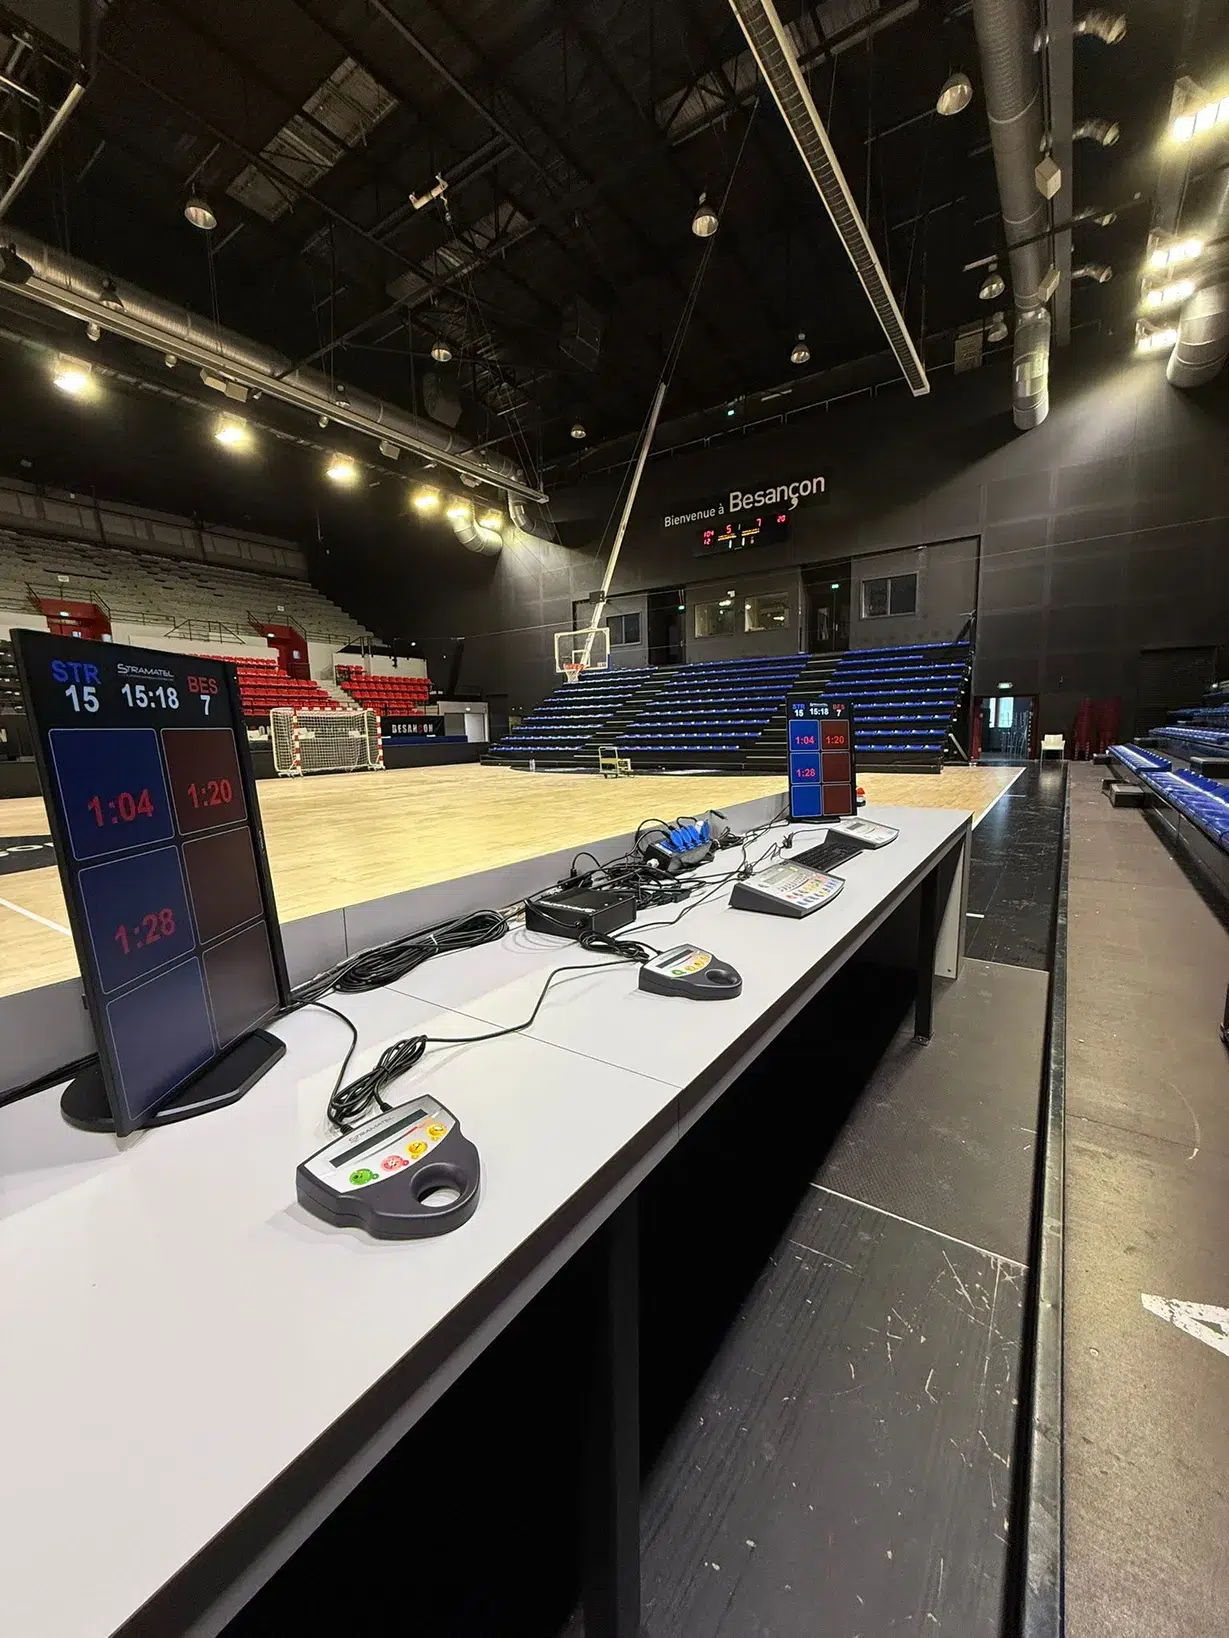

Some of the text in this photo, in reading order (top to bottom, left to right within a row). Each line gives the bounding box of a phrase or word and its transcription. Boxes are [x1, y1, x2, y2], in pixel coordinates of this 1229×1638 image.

[664, 476, 825, 527] Bienvenue à Besançon
[52, 660, 101, 685] STR
[117, 663, 175, 678] STRAMATEL
[188, 676, 219, 695] BES
[65, 685, 100, 713] 15
[121, 683, 180, 710] 15:18
[200, 695, 211, 716] 7
[794, 709, 804, 717] 15
[809, 707, 829, 716] 15:18
[836, 709, 842, 717] 7
[795, 736, 815, 745] 1:04
[825, 736, 845, 744] 1:20
[796, 768, 816, 777] 1:28
[187, 778, 233, 809] 1:20
[87, 788, 155, 828] 1:04
[114, 907, 176, 955] 1:28
